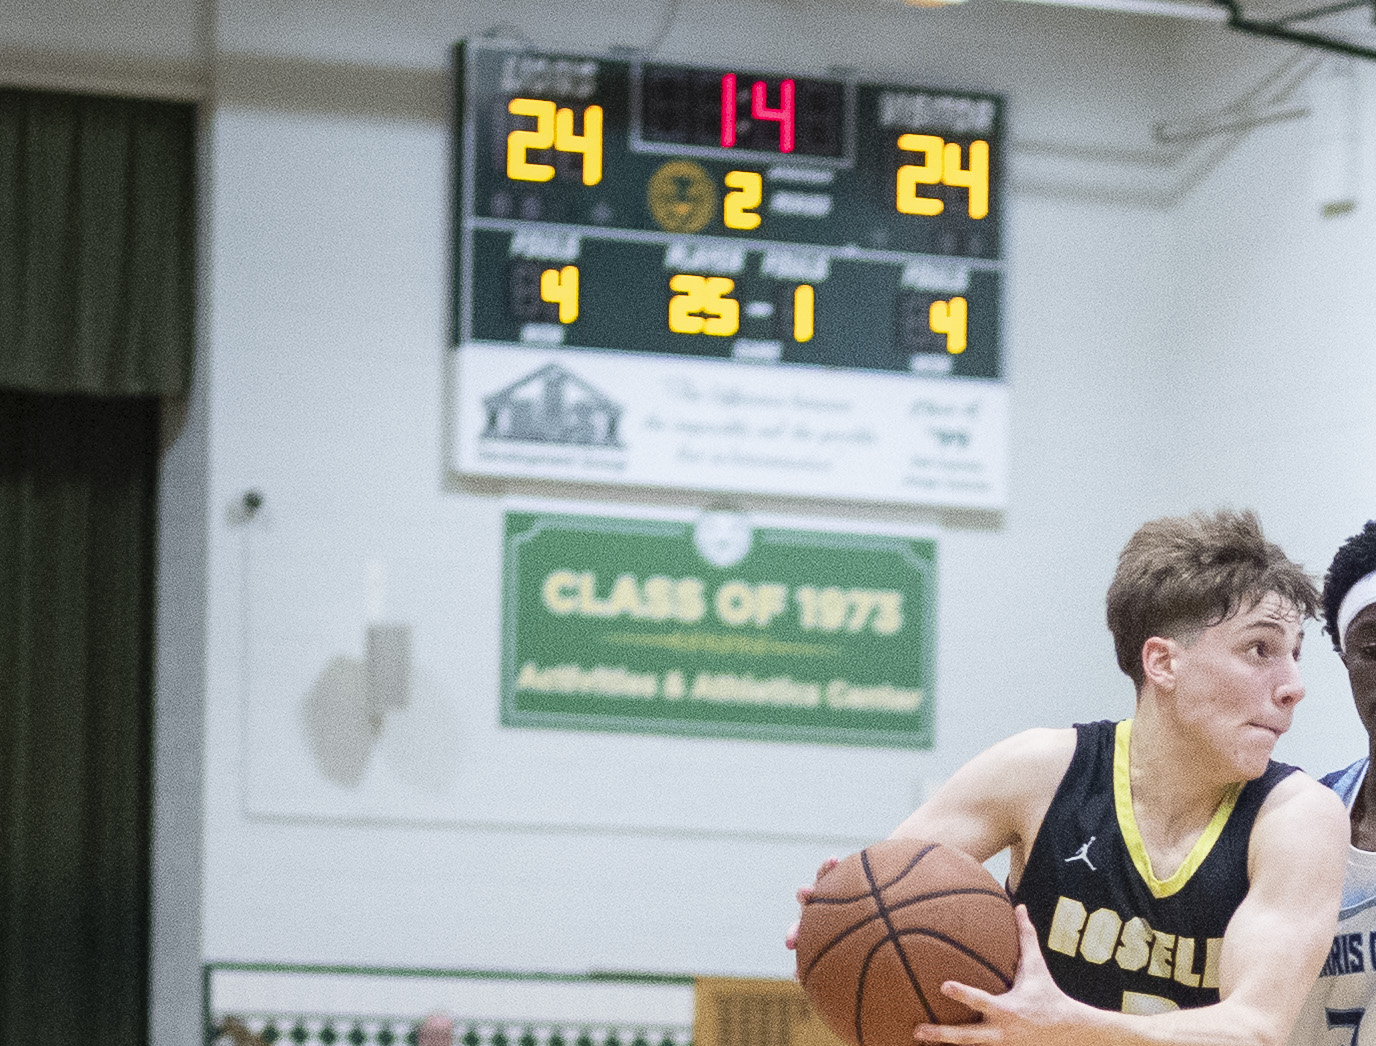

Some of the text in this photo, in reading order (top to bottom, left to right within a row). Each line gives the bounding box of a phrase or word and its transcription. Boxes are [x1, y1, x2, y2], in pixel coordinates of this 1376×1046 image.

[506, 98, 603, 186] 24
[721, 73, 795, 153] 14
[723, 171, 762, 229] 2
[896, 133, 989, 219] 24
[540, 265, 579, 324] 4
[669, 274, 739, 336] 25
[794, 284, 814, 342] 1
[929, 297, 967, 354] 4
[543, 570, 703, 622] CLASS
[715, 581, 786, 627] OF
[518, 664, 657, 697] Activities
[692, 672, 820, 707] Athletics
[827, 680, 924, 713] Center
[1047, 896, 1225, 988] ROSELL
